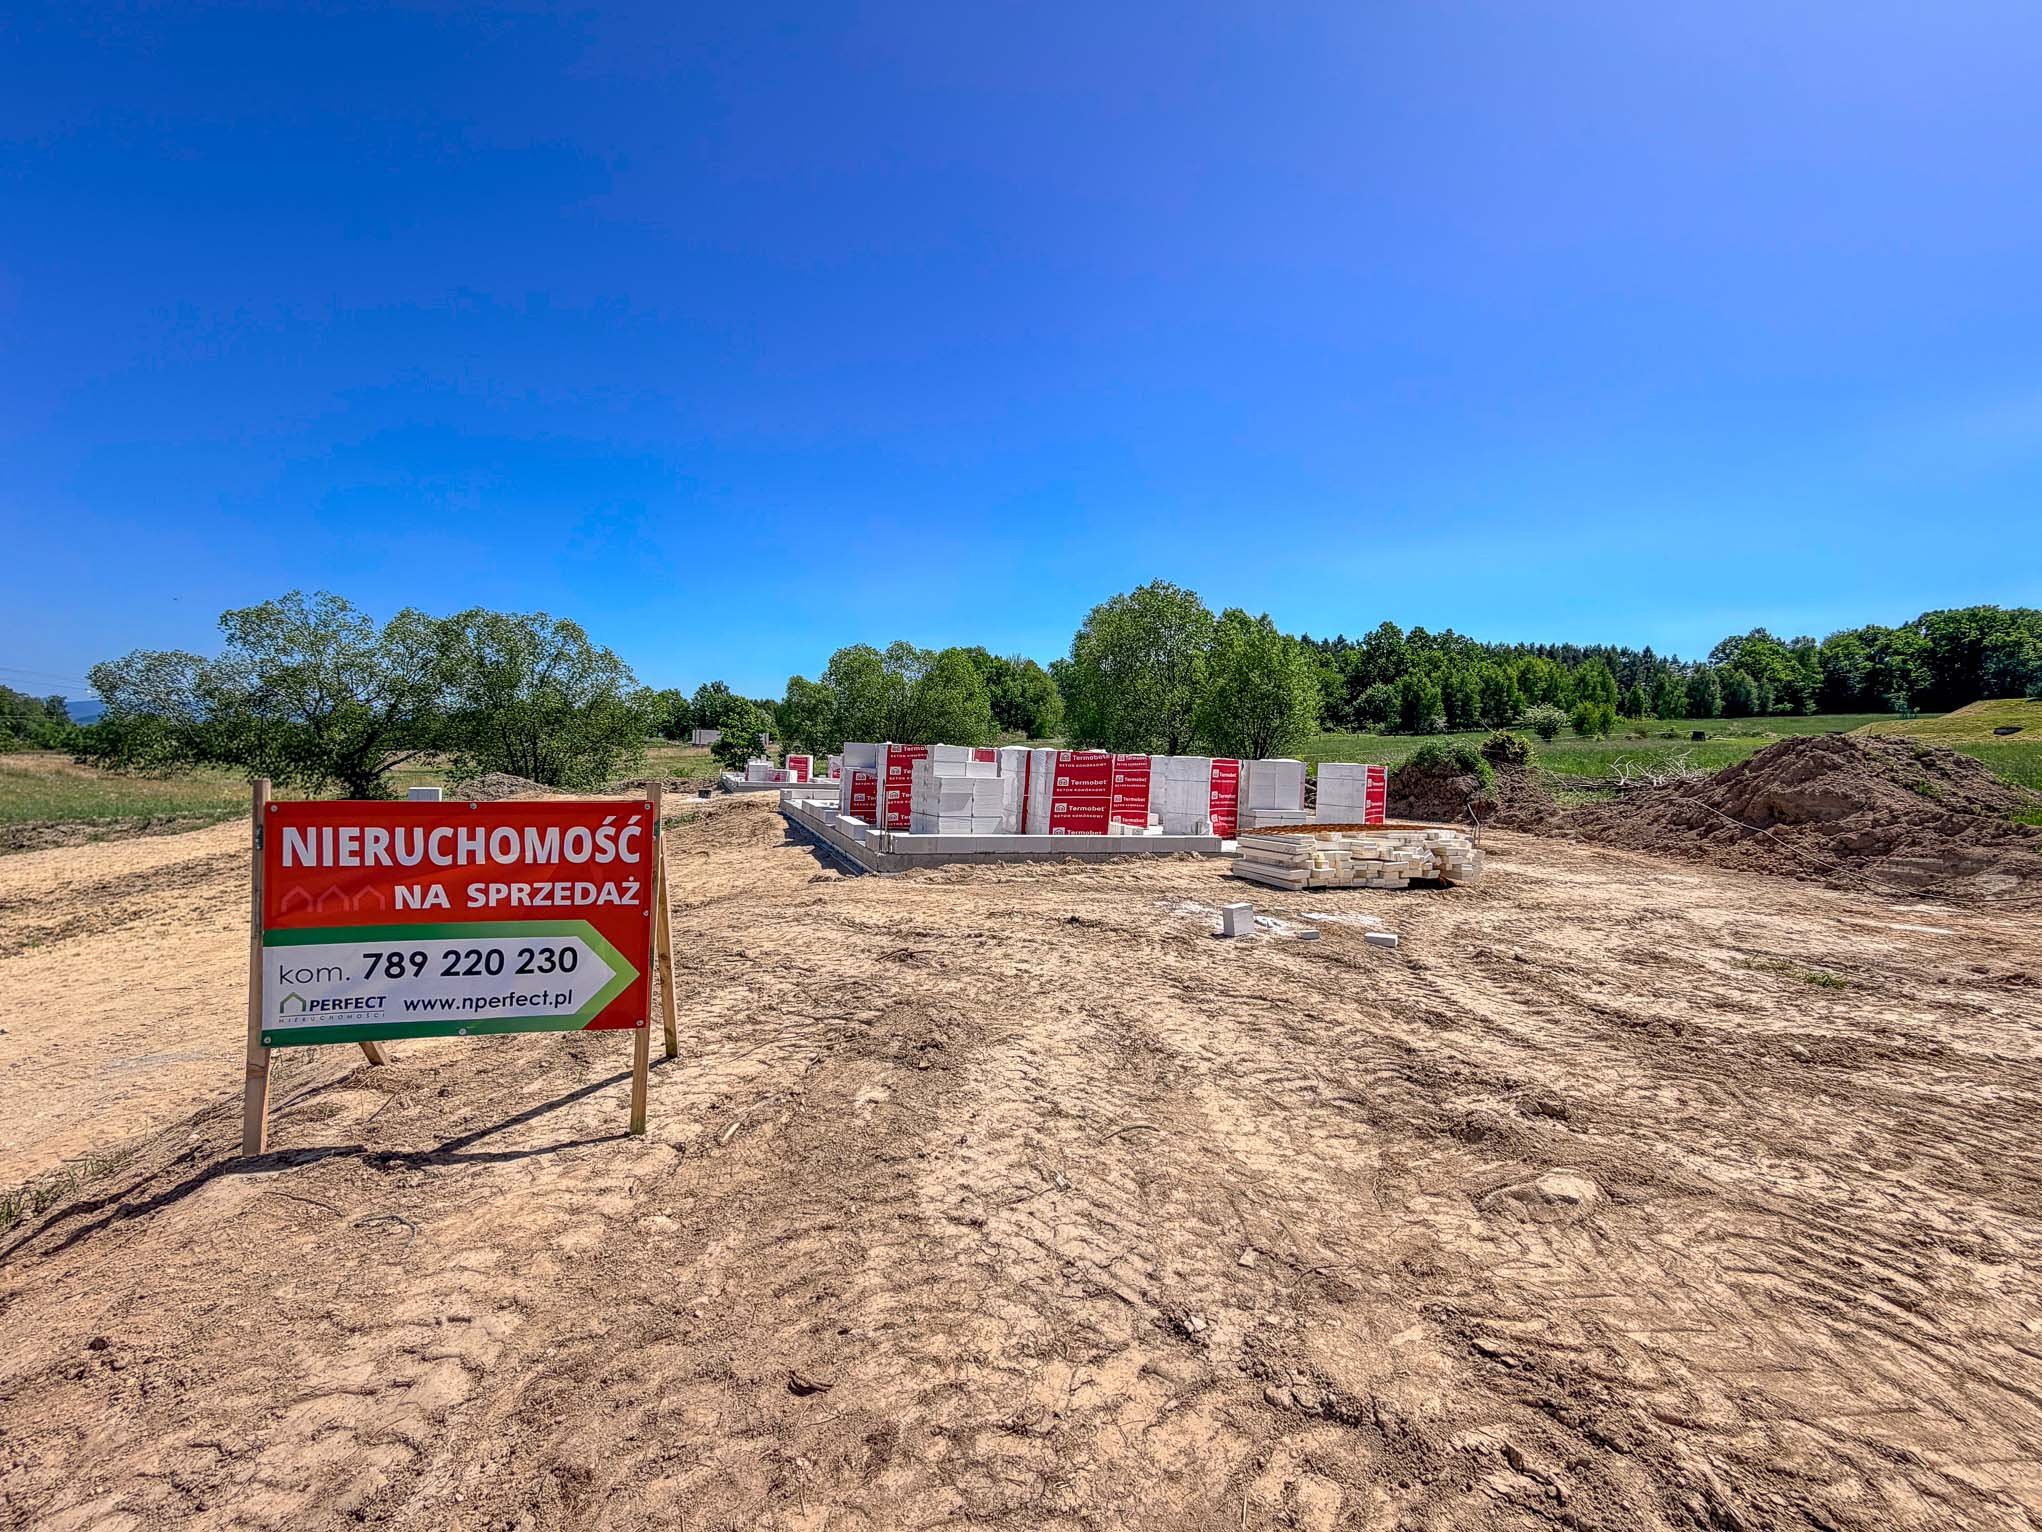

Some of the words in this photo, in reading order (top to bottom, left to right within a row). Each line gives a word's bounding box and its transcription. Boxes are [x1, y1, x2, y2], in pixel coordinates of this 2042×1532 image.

[281, 815, 642, 867] NIERUCHOMOŚĆ
[394, 884, 451, 910] NA
[466, 876, 641, 907] SPRZEDAŻ
[279, 964, 350, 985] kom.
[362, 950, 429, 981] 789
[440, 948, 505, 977] 220
[515, 946, 578, 975] 230
[309, 996, 387, 1012] PERFECT
[403, 989, 573, 1013] www.nperfect.pl
